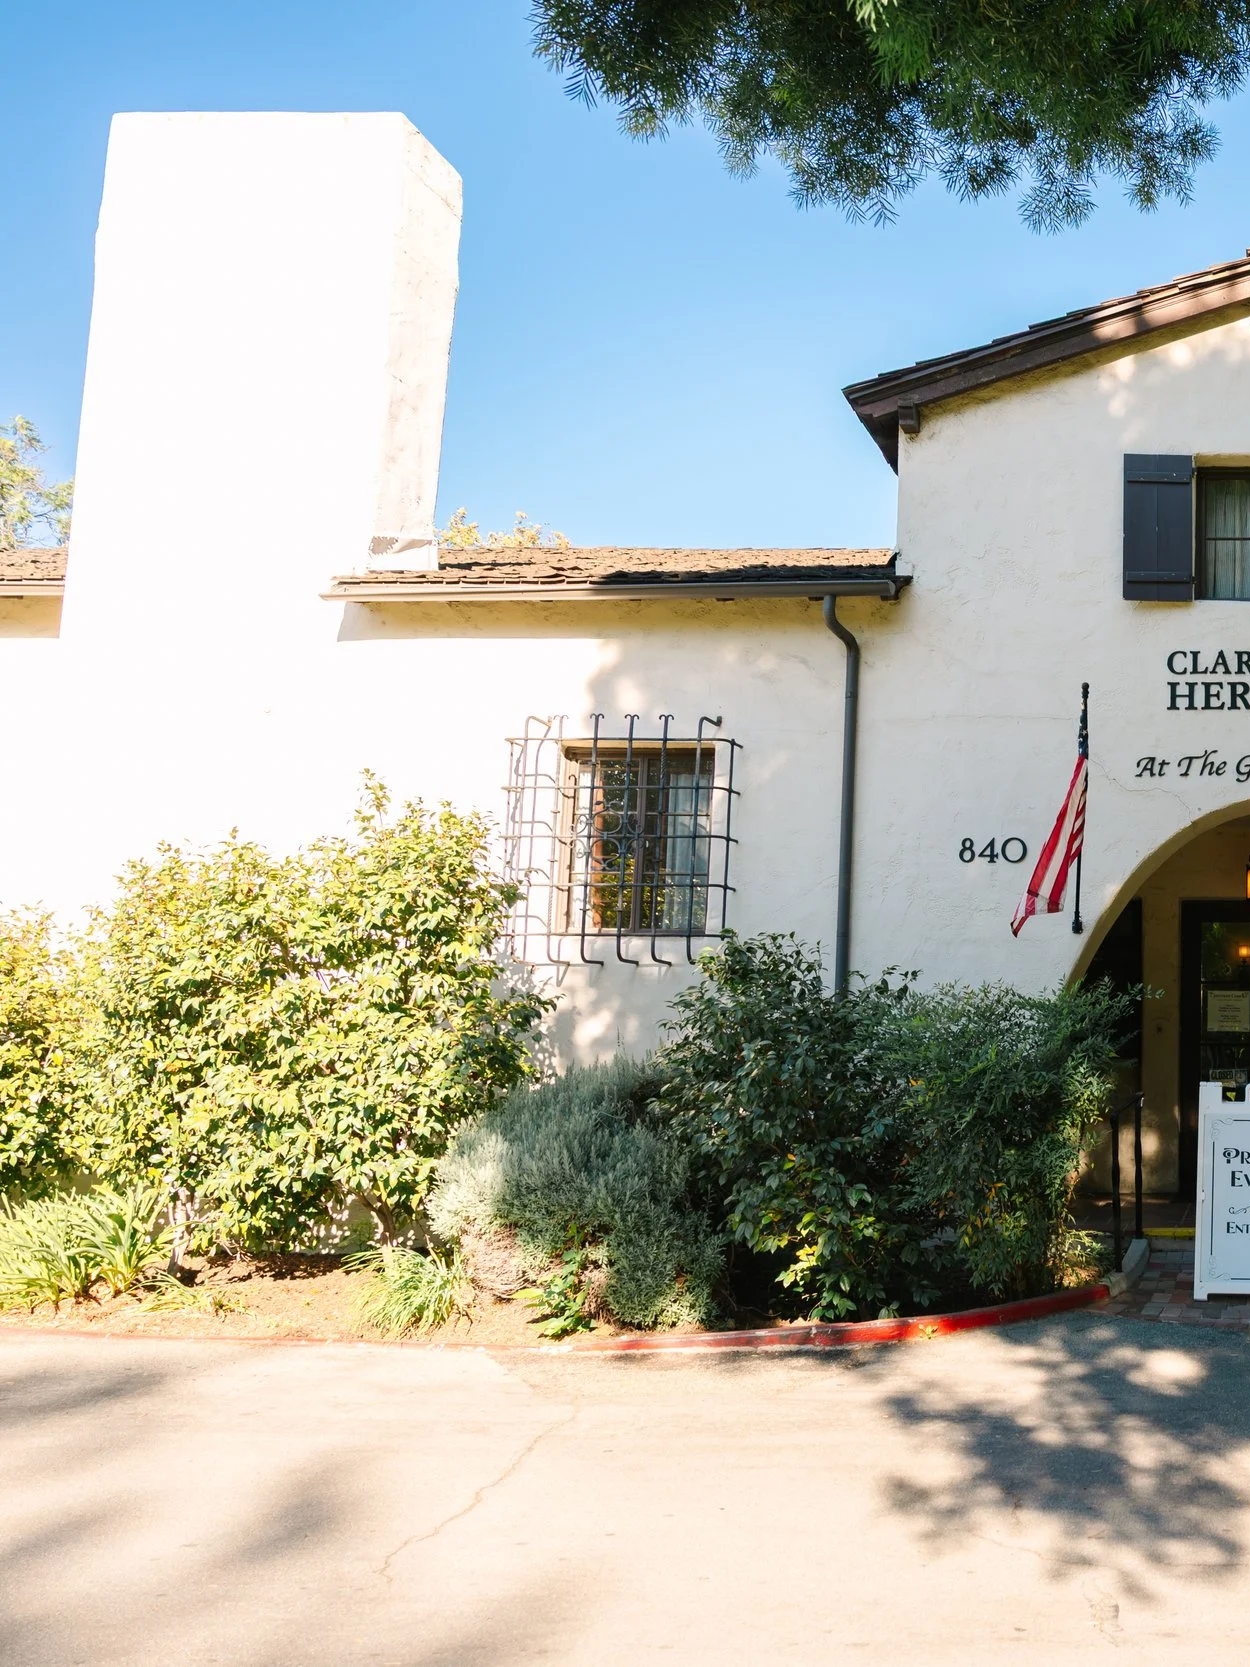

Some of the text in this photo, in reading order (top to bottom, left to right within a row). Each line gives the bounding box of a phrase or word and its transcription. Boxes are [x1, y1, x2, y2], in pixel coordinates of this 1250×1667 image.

[1135, 756, 1170, 778] At
[1177, 749, 1227, 777] The
[959, 837, 1028, 864] 840
[1211, 1070, 1233, 1080] CLOSED
